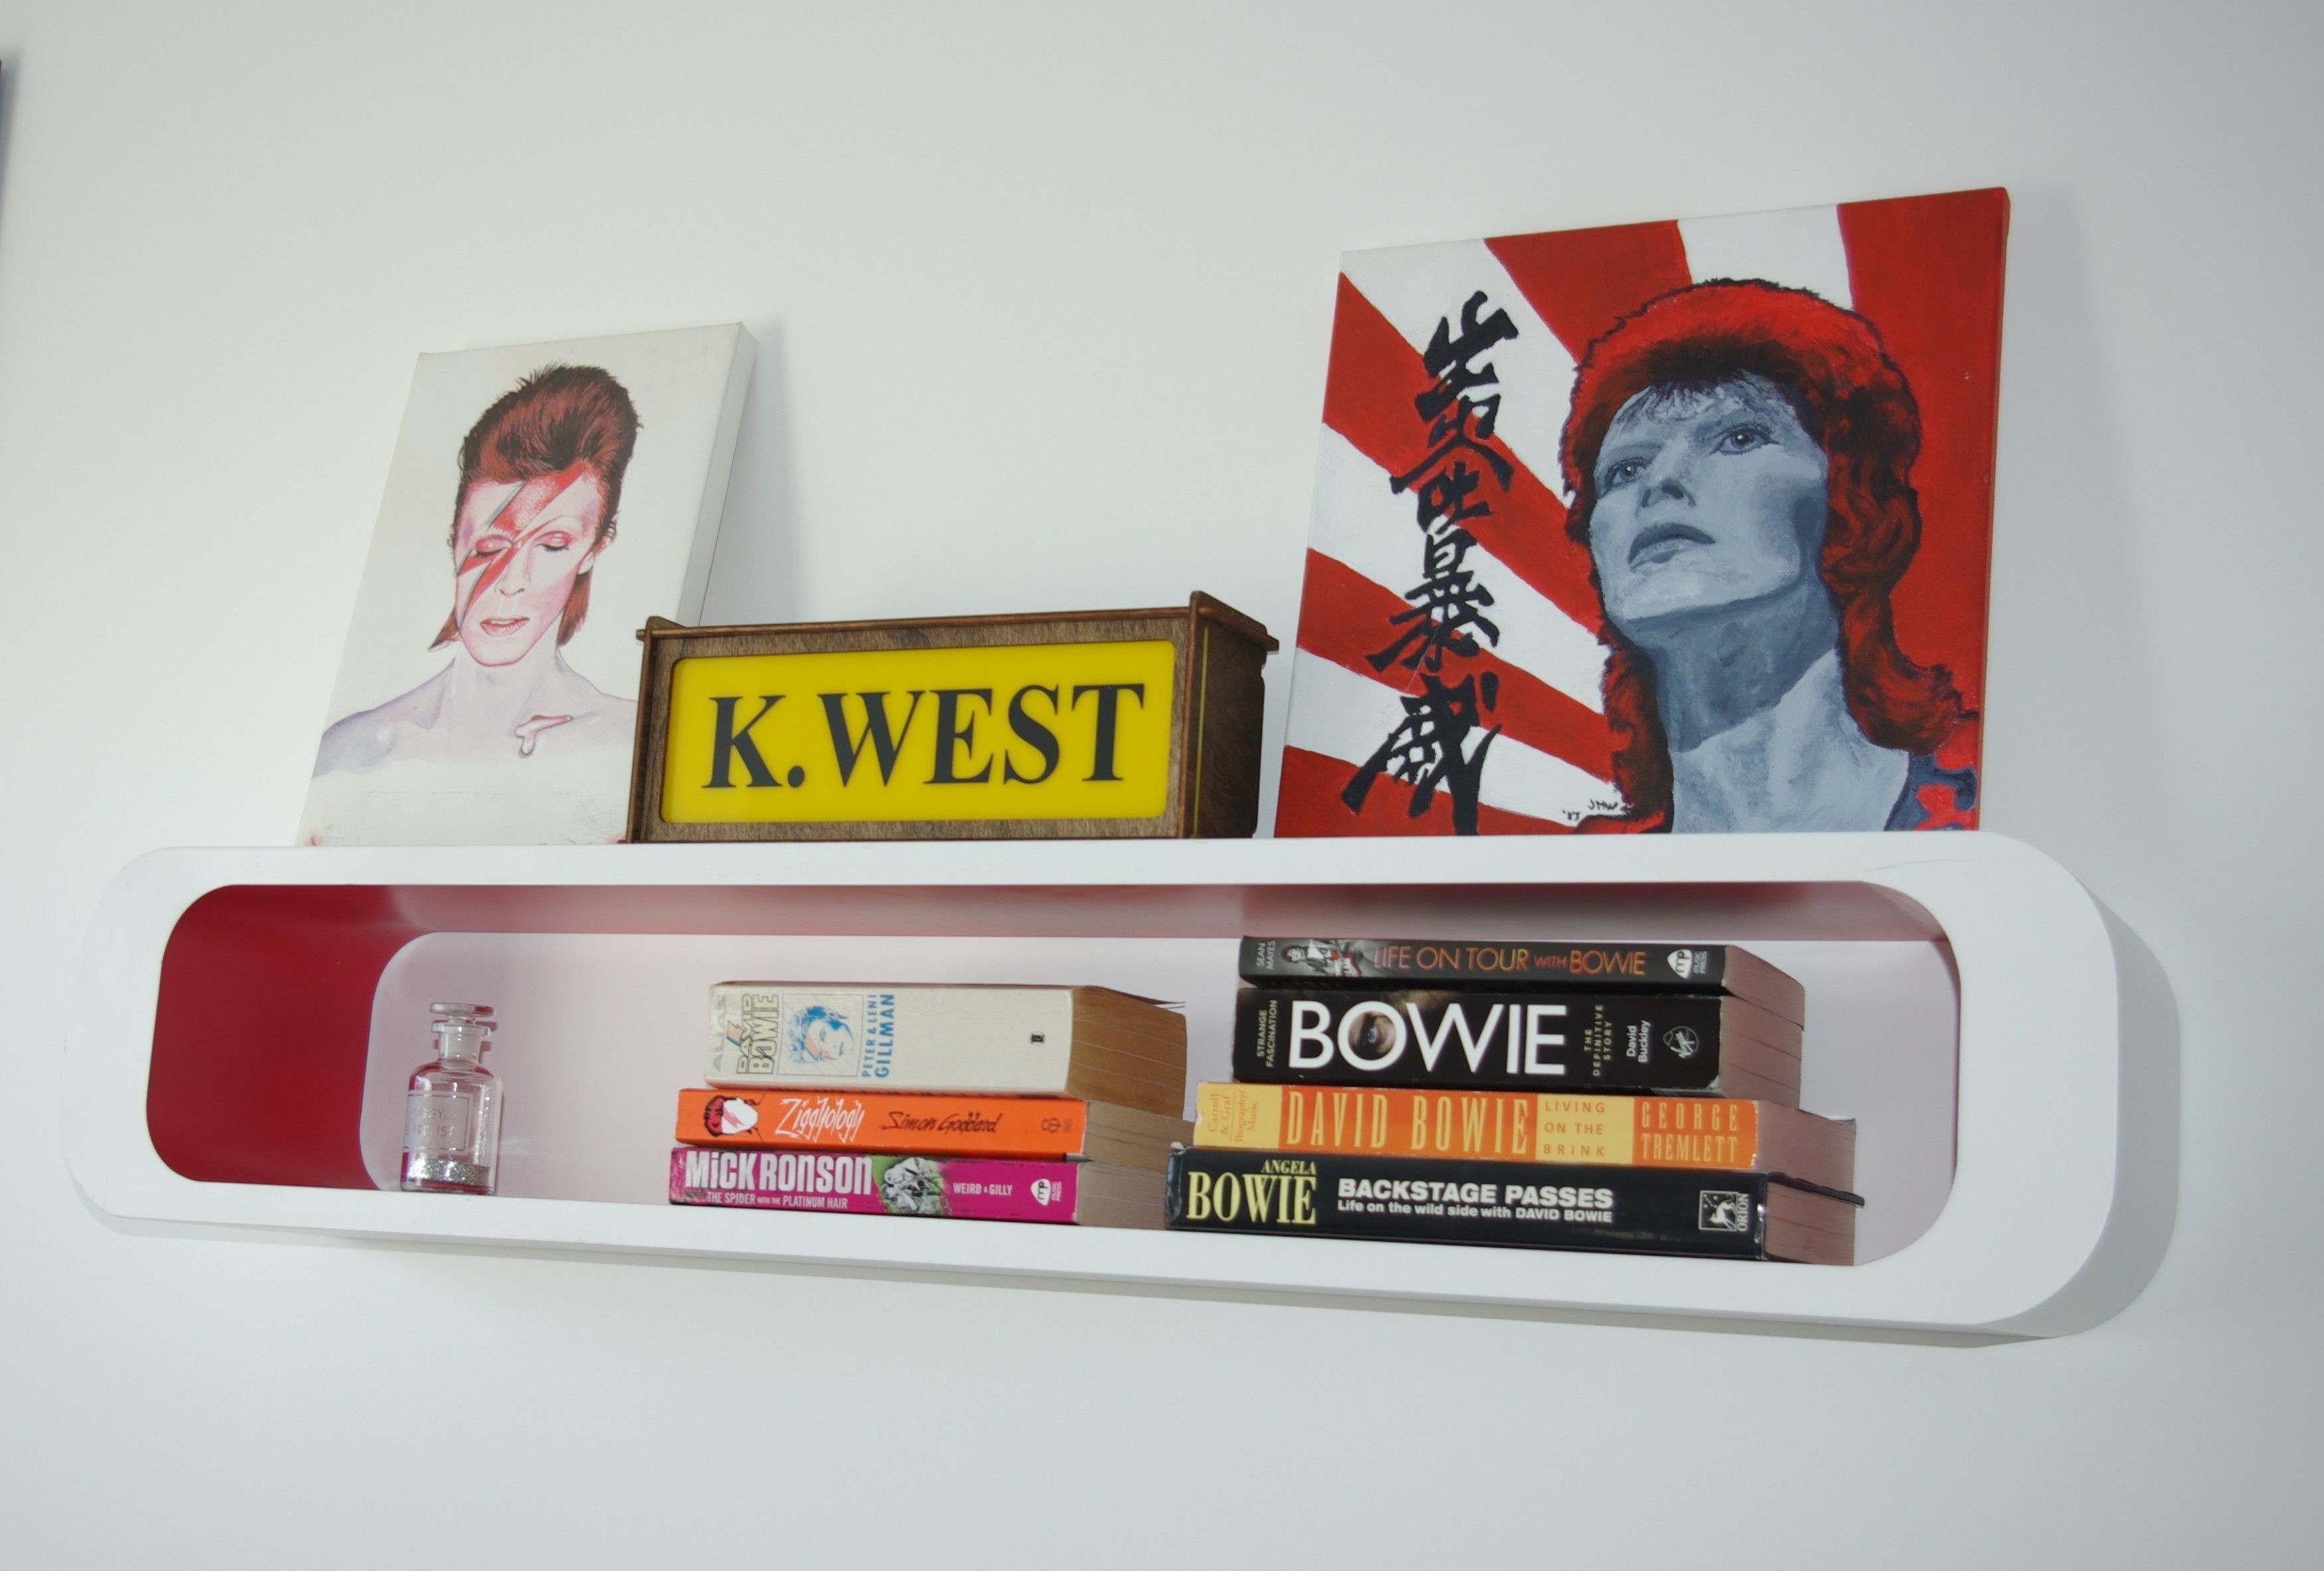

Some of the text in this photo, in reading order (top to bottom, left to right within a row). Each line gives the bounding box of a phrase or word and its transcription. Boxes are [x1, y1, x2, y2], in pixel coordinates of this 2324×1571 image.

[701, 682, 1145, 789] K.WEST
[1256, 942, 1265, 967] SEAN
[1266, 940, 1276, 970] MAYES
[1374, 945, 1647, 976] LIFE ON TOUR WITH BOWIE
[736, 994, 753, 1074] DAVID
[748, 994, 780, 1075] BOWIE
[861, 994, 877, 1077] PETER & LENI
[874, 994, 895, 1078] GILLMAN
[1256, 1009, 1267, 1058] STRANGE
[1266, 999, 1278, 1068] FASCINATION
[1289, 1000, 1567, 1075] BOWIE
[1584, 1028, 1593, 1052] THE
[1592, 1004, 1604, 1077] DEFINITIVE
[1603, 1021, 1613, 1061] STORY
[1626, 1025, 1637, 1057] David
[1637, 1019, 1651, 1063] Buckley
[880, 1111, 938, 1131] Simon
[1208, 1093, 1219, 1132] Carroll
[1220, 1093, 1231, 1135] & Graf
[1233, 1089, 1249, 1142] Biography/
[1246, 1100, 1257, 1132] Music
[1286, 1091, 1528, 1155] DAVID BOWIE
[1544, 1101, 1606, 1114] LIVING
[1641, 1101, 1738, 1131] GEORGE
[1544, 1122, 1604, 1135] ON THE
[1543, 1143, 1606, 1157] BRINK
[1641, 1133, 1739, 1163] TREMLETT
[1261, 1159, 1317, 1175] ANGELA
[707, 1191, 722, 1204] THE
[724, 1192, 756, 1205] SPIDER
[771, 1197, 782, 1205] THE
[782, 1195, 825, 1208] PLATINUM
[827, 1198, 848, 1209] HAIR
[952, 1182, 981, 1196] WEIRD
[989, 1183, 1013, 1196] GILLY
[1186, 1170, 1317, 1225] BOWIE
[1338, 1178, 1614, 1209] BACKSTAGE PASSES
[1338, 1199, 1613, 1223] Life on the wild side with DAVID BOWIE
[1737, 1193, 1749, 1232] ORION
